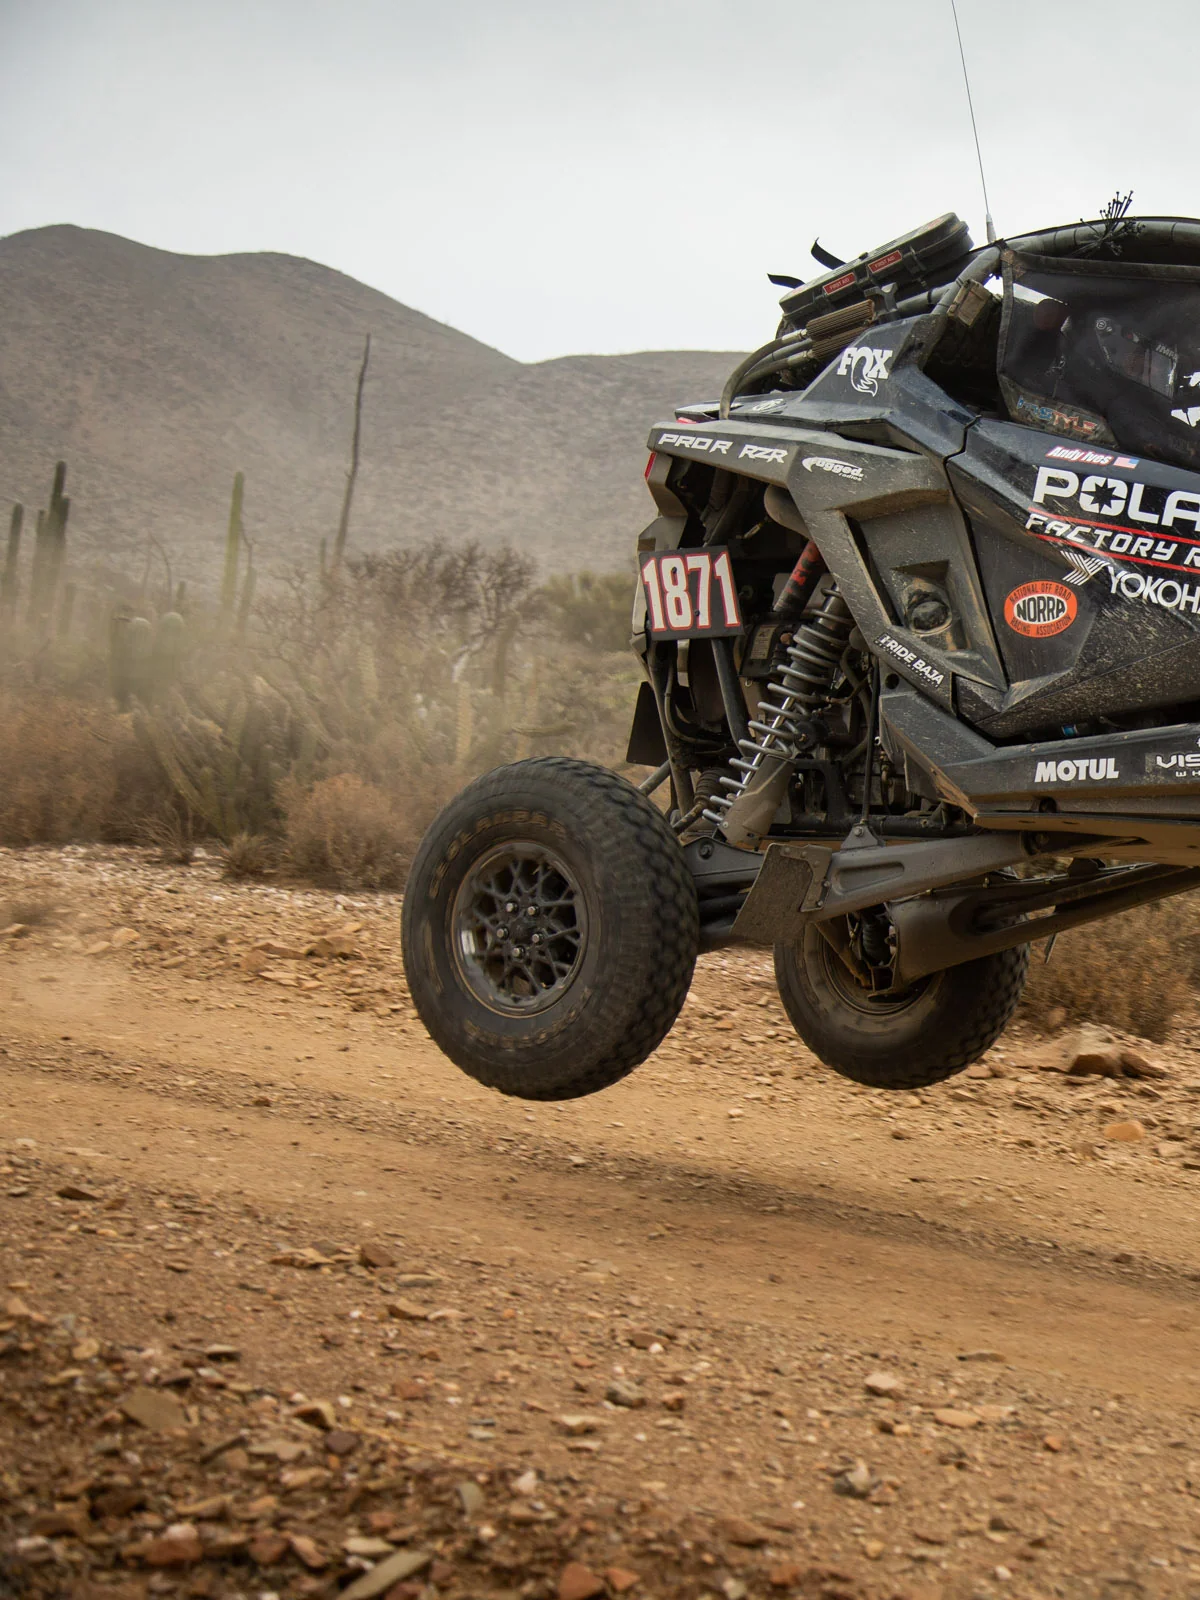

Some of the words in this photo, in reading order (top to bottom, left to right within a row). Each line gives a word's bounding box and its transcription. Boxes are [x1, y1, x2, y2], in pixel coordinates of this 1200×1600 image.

[837, 346, 893, 397] FOX
[658, 433, 707, 451] PRO
[711, 440, 733, 454] R
[738, 444, 788, 463] RZR
[1047, 446, 1080, 464] Andy
[1080, 450, 1113, 466] Ives
[1025, 513, 1178, 562] FACTORY
[642, 551, 740, 630] 1871
[1055, 584, 1072, 600] ROAD
[1016, 595, 1066, 622] NORRA
[886, 640, 917, 663] RIDE
[913, 659, 944, 684] BAJA
[1034, 758, 1119, 783] MOTUL
